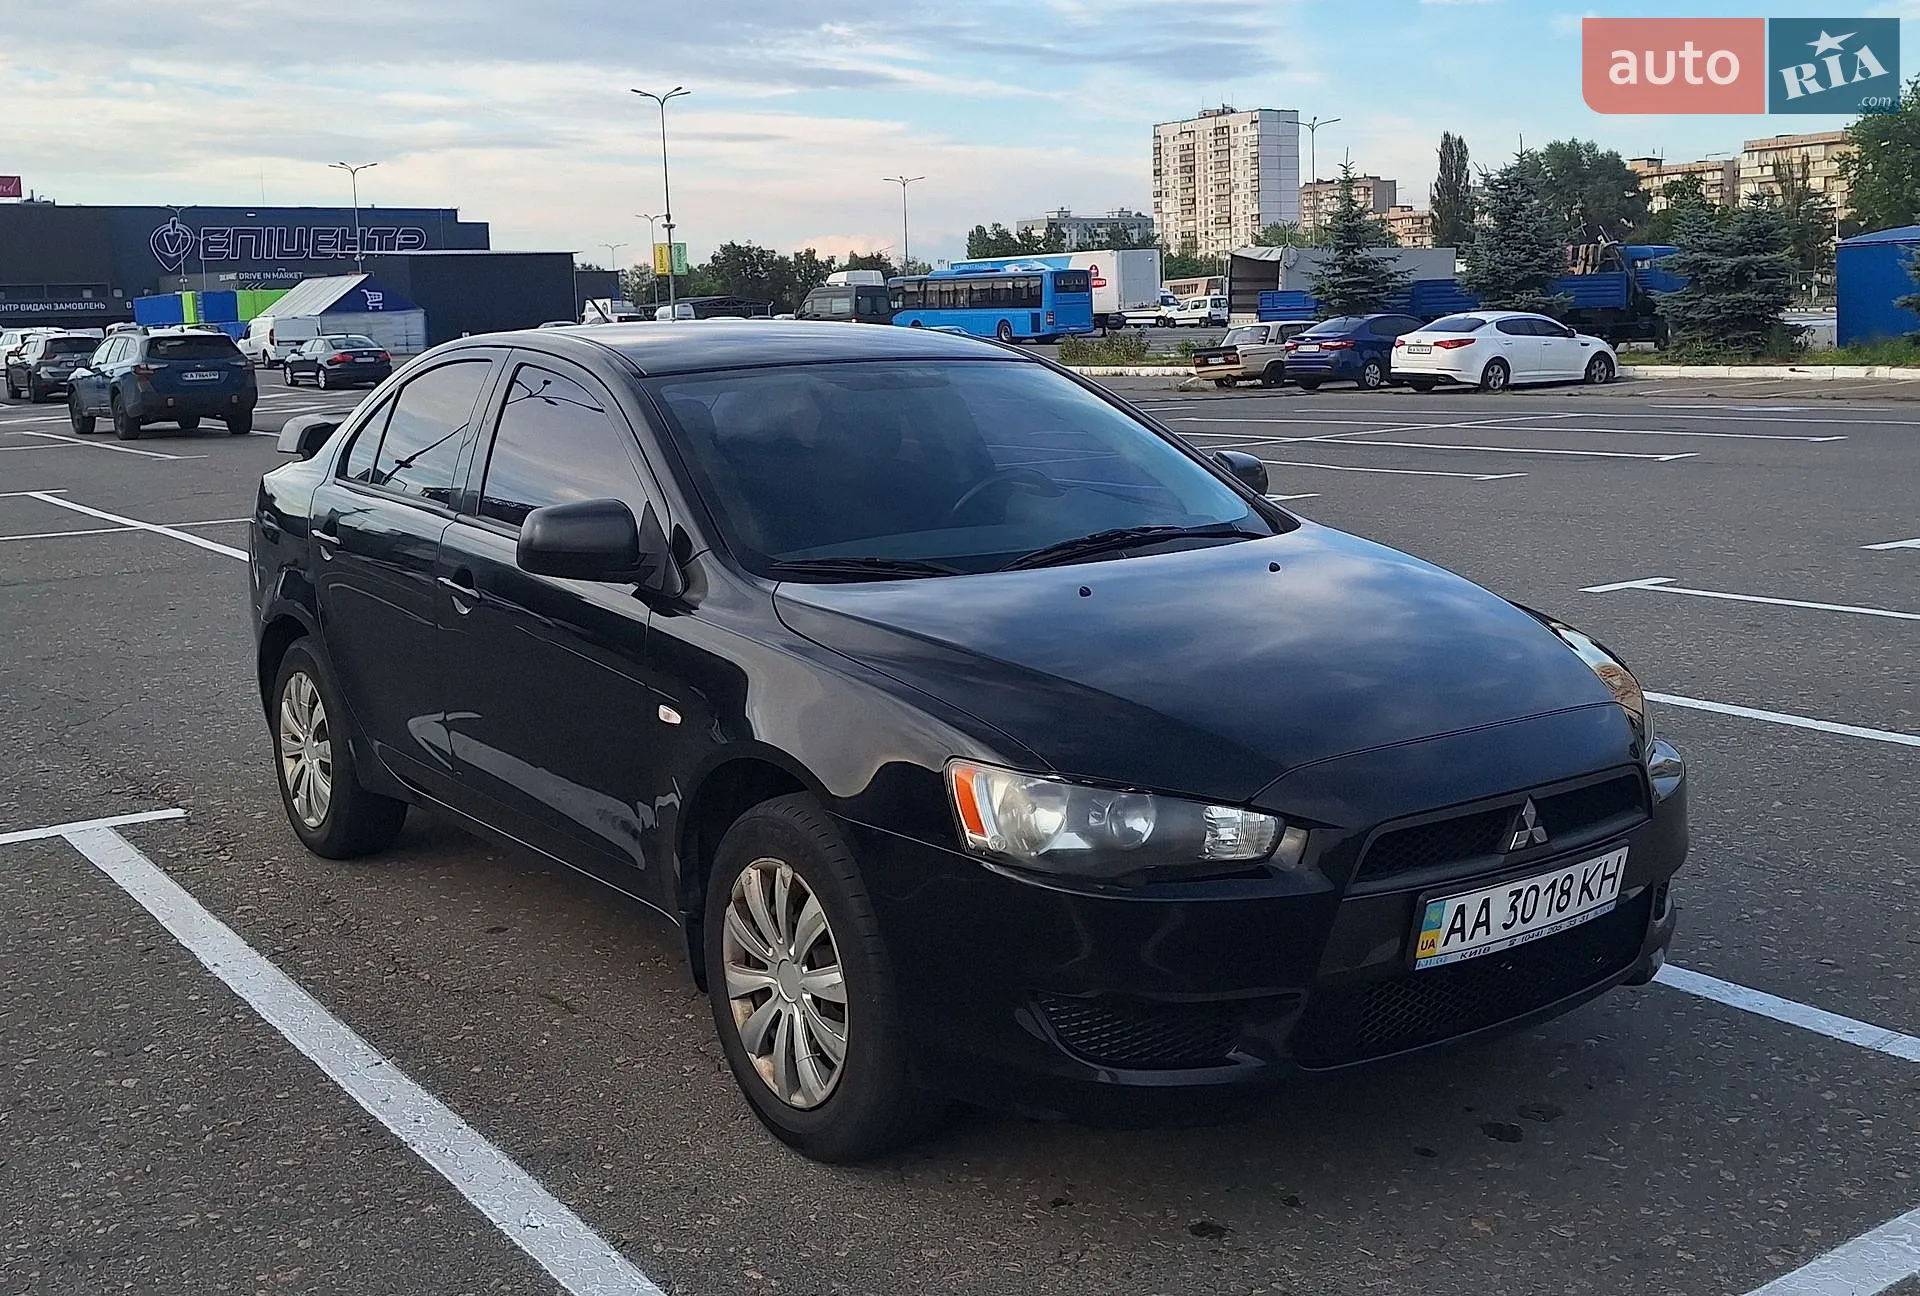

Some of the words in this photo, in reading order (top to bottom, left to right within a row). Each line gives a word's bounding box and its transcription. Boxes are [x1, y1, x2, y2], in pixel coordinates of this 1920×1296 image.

[200, 226, 428, 260] ЕПІЦЕНТР
[238, 272, 262, 280] DRIVE
[272, 271, 304, 279] MARKET
[20, 303, 52, 312] ВИДАЧІ
[53, 302, 106, 311] ЗАМОВЛЕНЬ
[1442, 896, 1491, 947] AA
[1501, 873, 1575, 930] 3018
[1577, 854, 1622, 907] KH
[1420, 938, 1436, 951] UA
